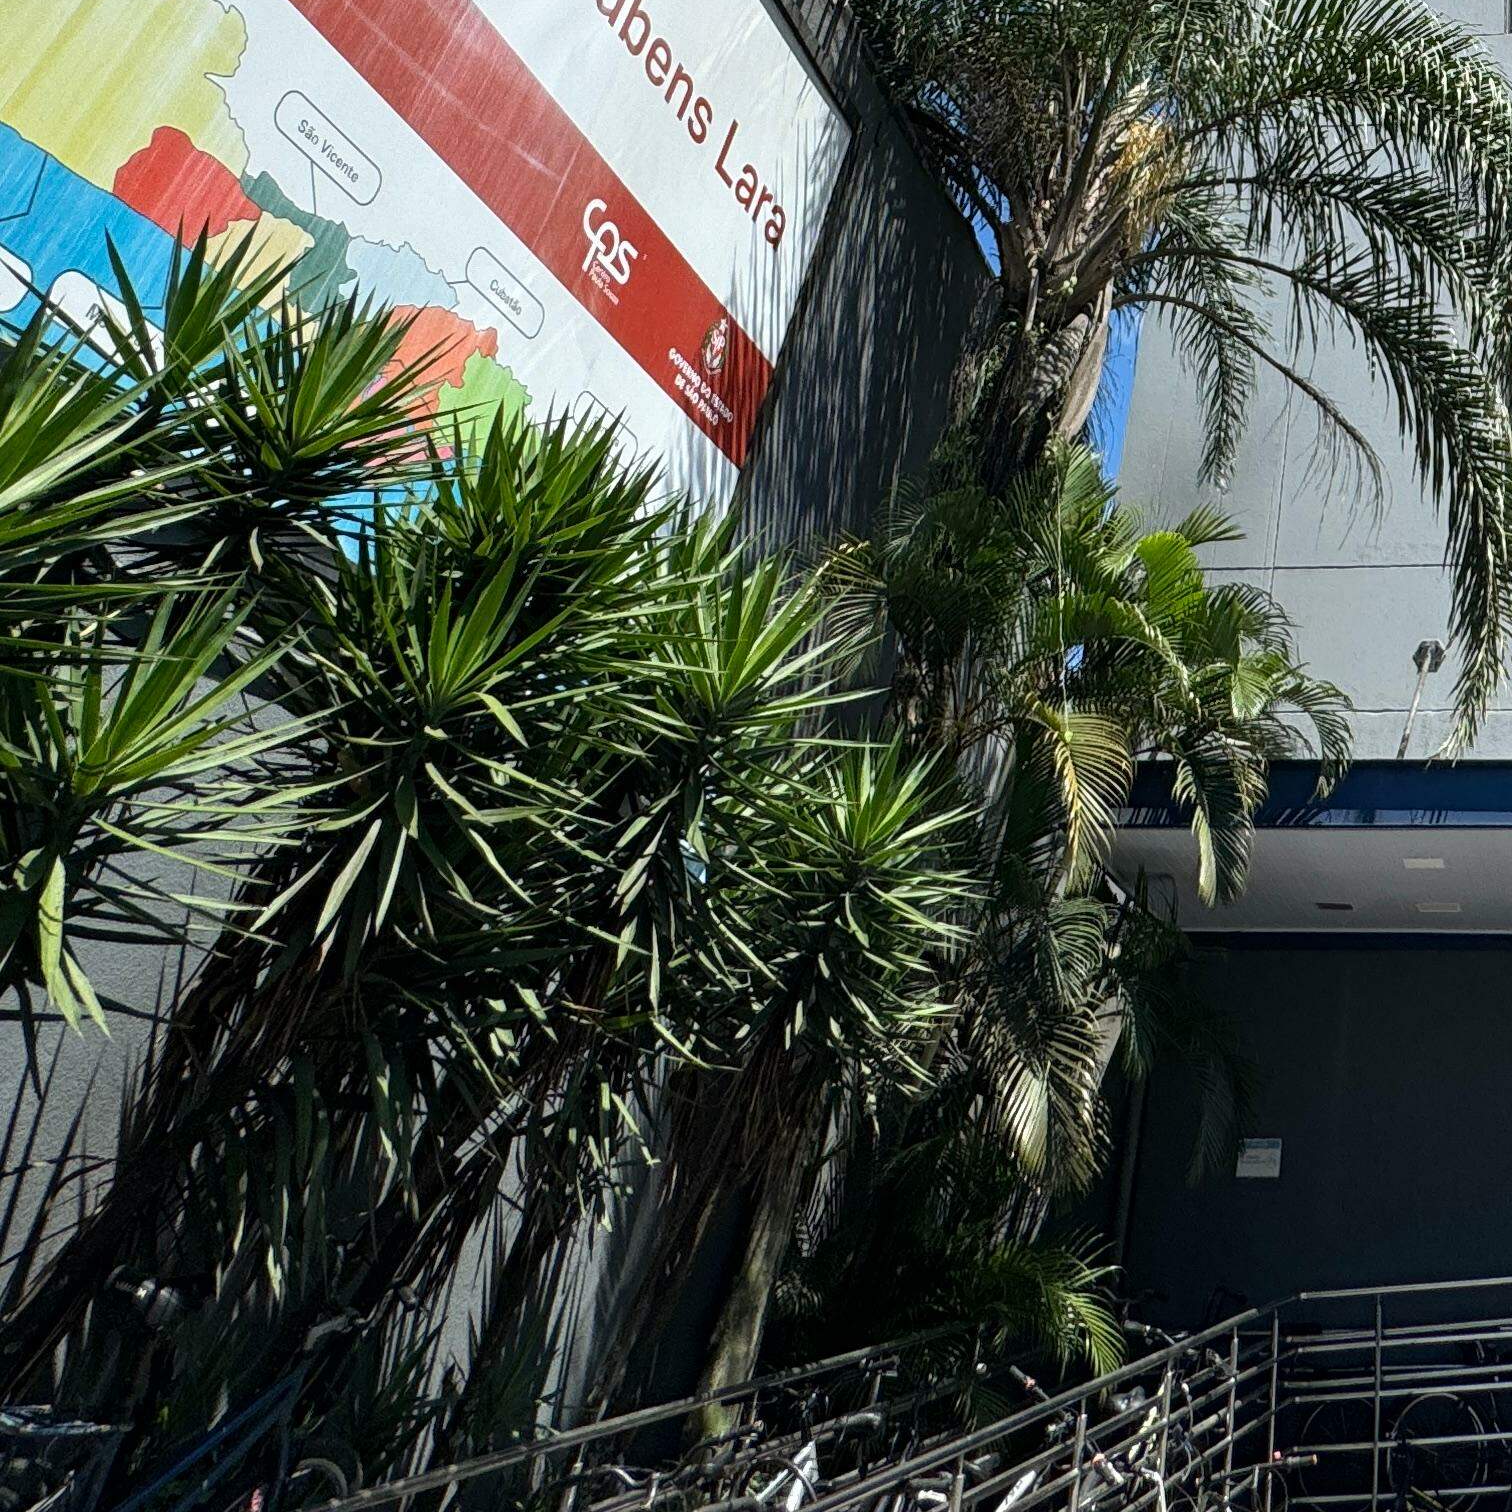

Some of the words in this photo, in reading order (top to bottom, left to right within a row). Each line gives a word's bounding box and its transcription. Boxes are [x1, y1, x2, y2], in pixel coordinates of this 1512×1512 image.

[298, 119, 319, 145] São
[320, 139, 359, 183] Vicente
[715, 119, 787, 249] Lara
[490, 279, 522, 315] Cubatão
